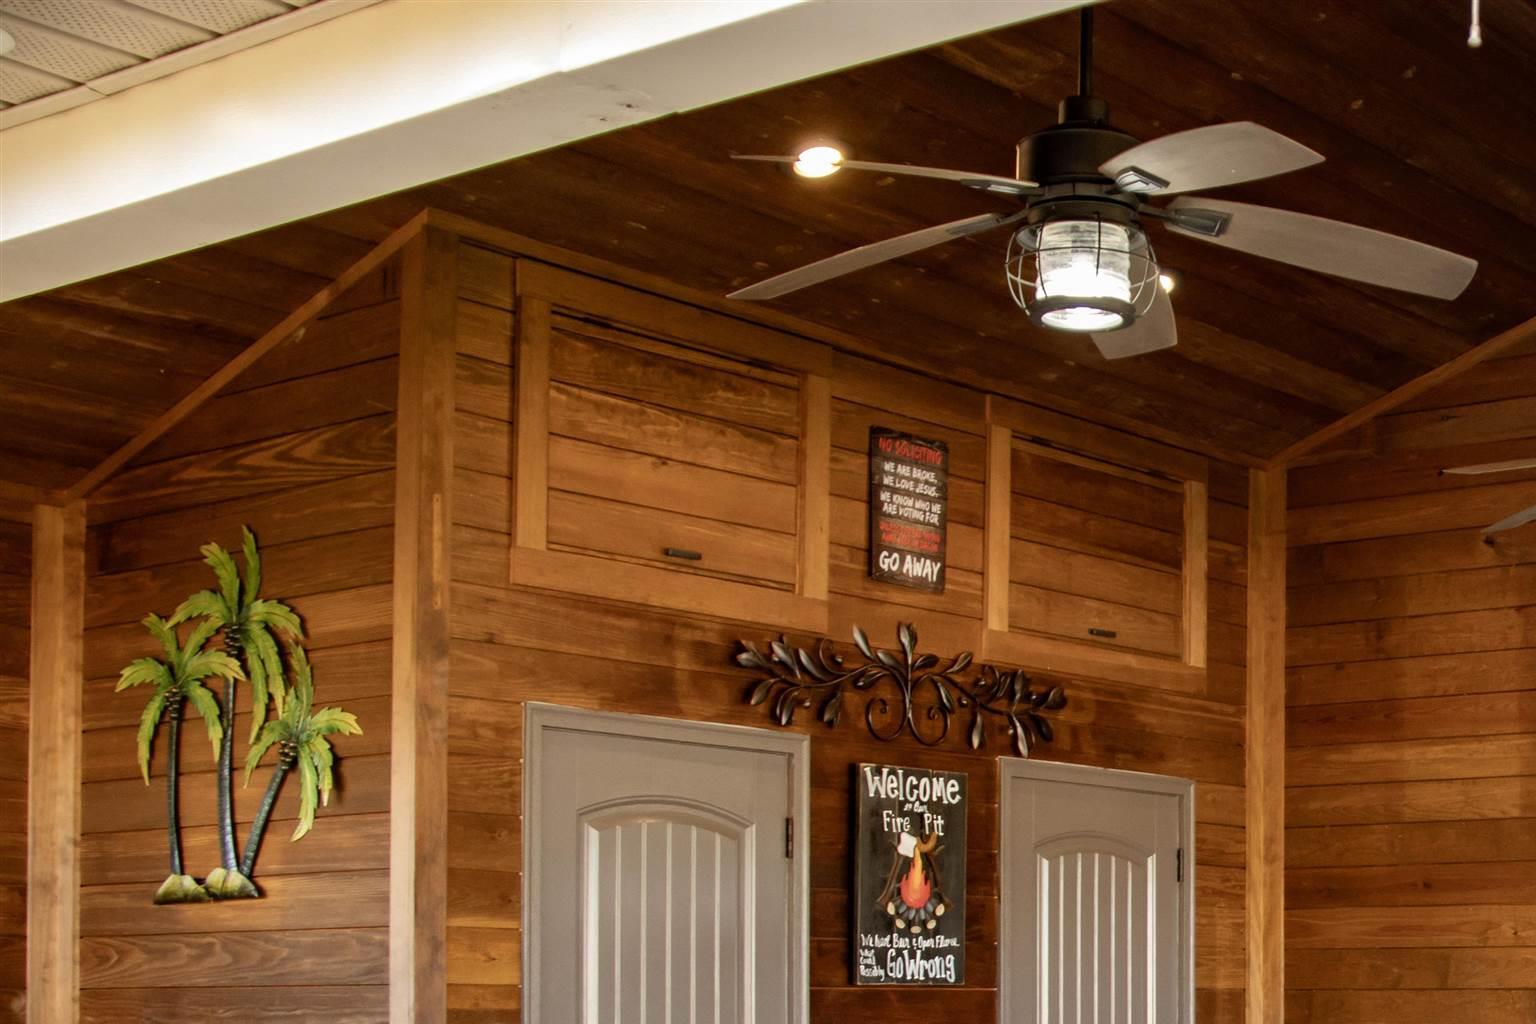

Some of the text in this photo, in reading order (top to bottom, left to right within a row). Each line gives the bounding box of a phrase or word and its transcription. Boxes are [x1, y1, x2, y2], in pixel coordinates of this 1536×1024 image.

[879, 437, 892, 452] NO
[883, 474, 894, 486] WE
[895, 478, 914, 491] LOVE
[884, 461, 938, 484] WE ARE BROKE,
[880, 491, 941, 514] WE KNOW WHO WE
[883, 502, 939, 526] ARE VOTING FOR
[879, 551, 941, 582] GO AWAY
[883, 810, 944, 836] Fire Pit
[861, 933, 873, 947] We
